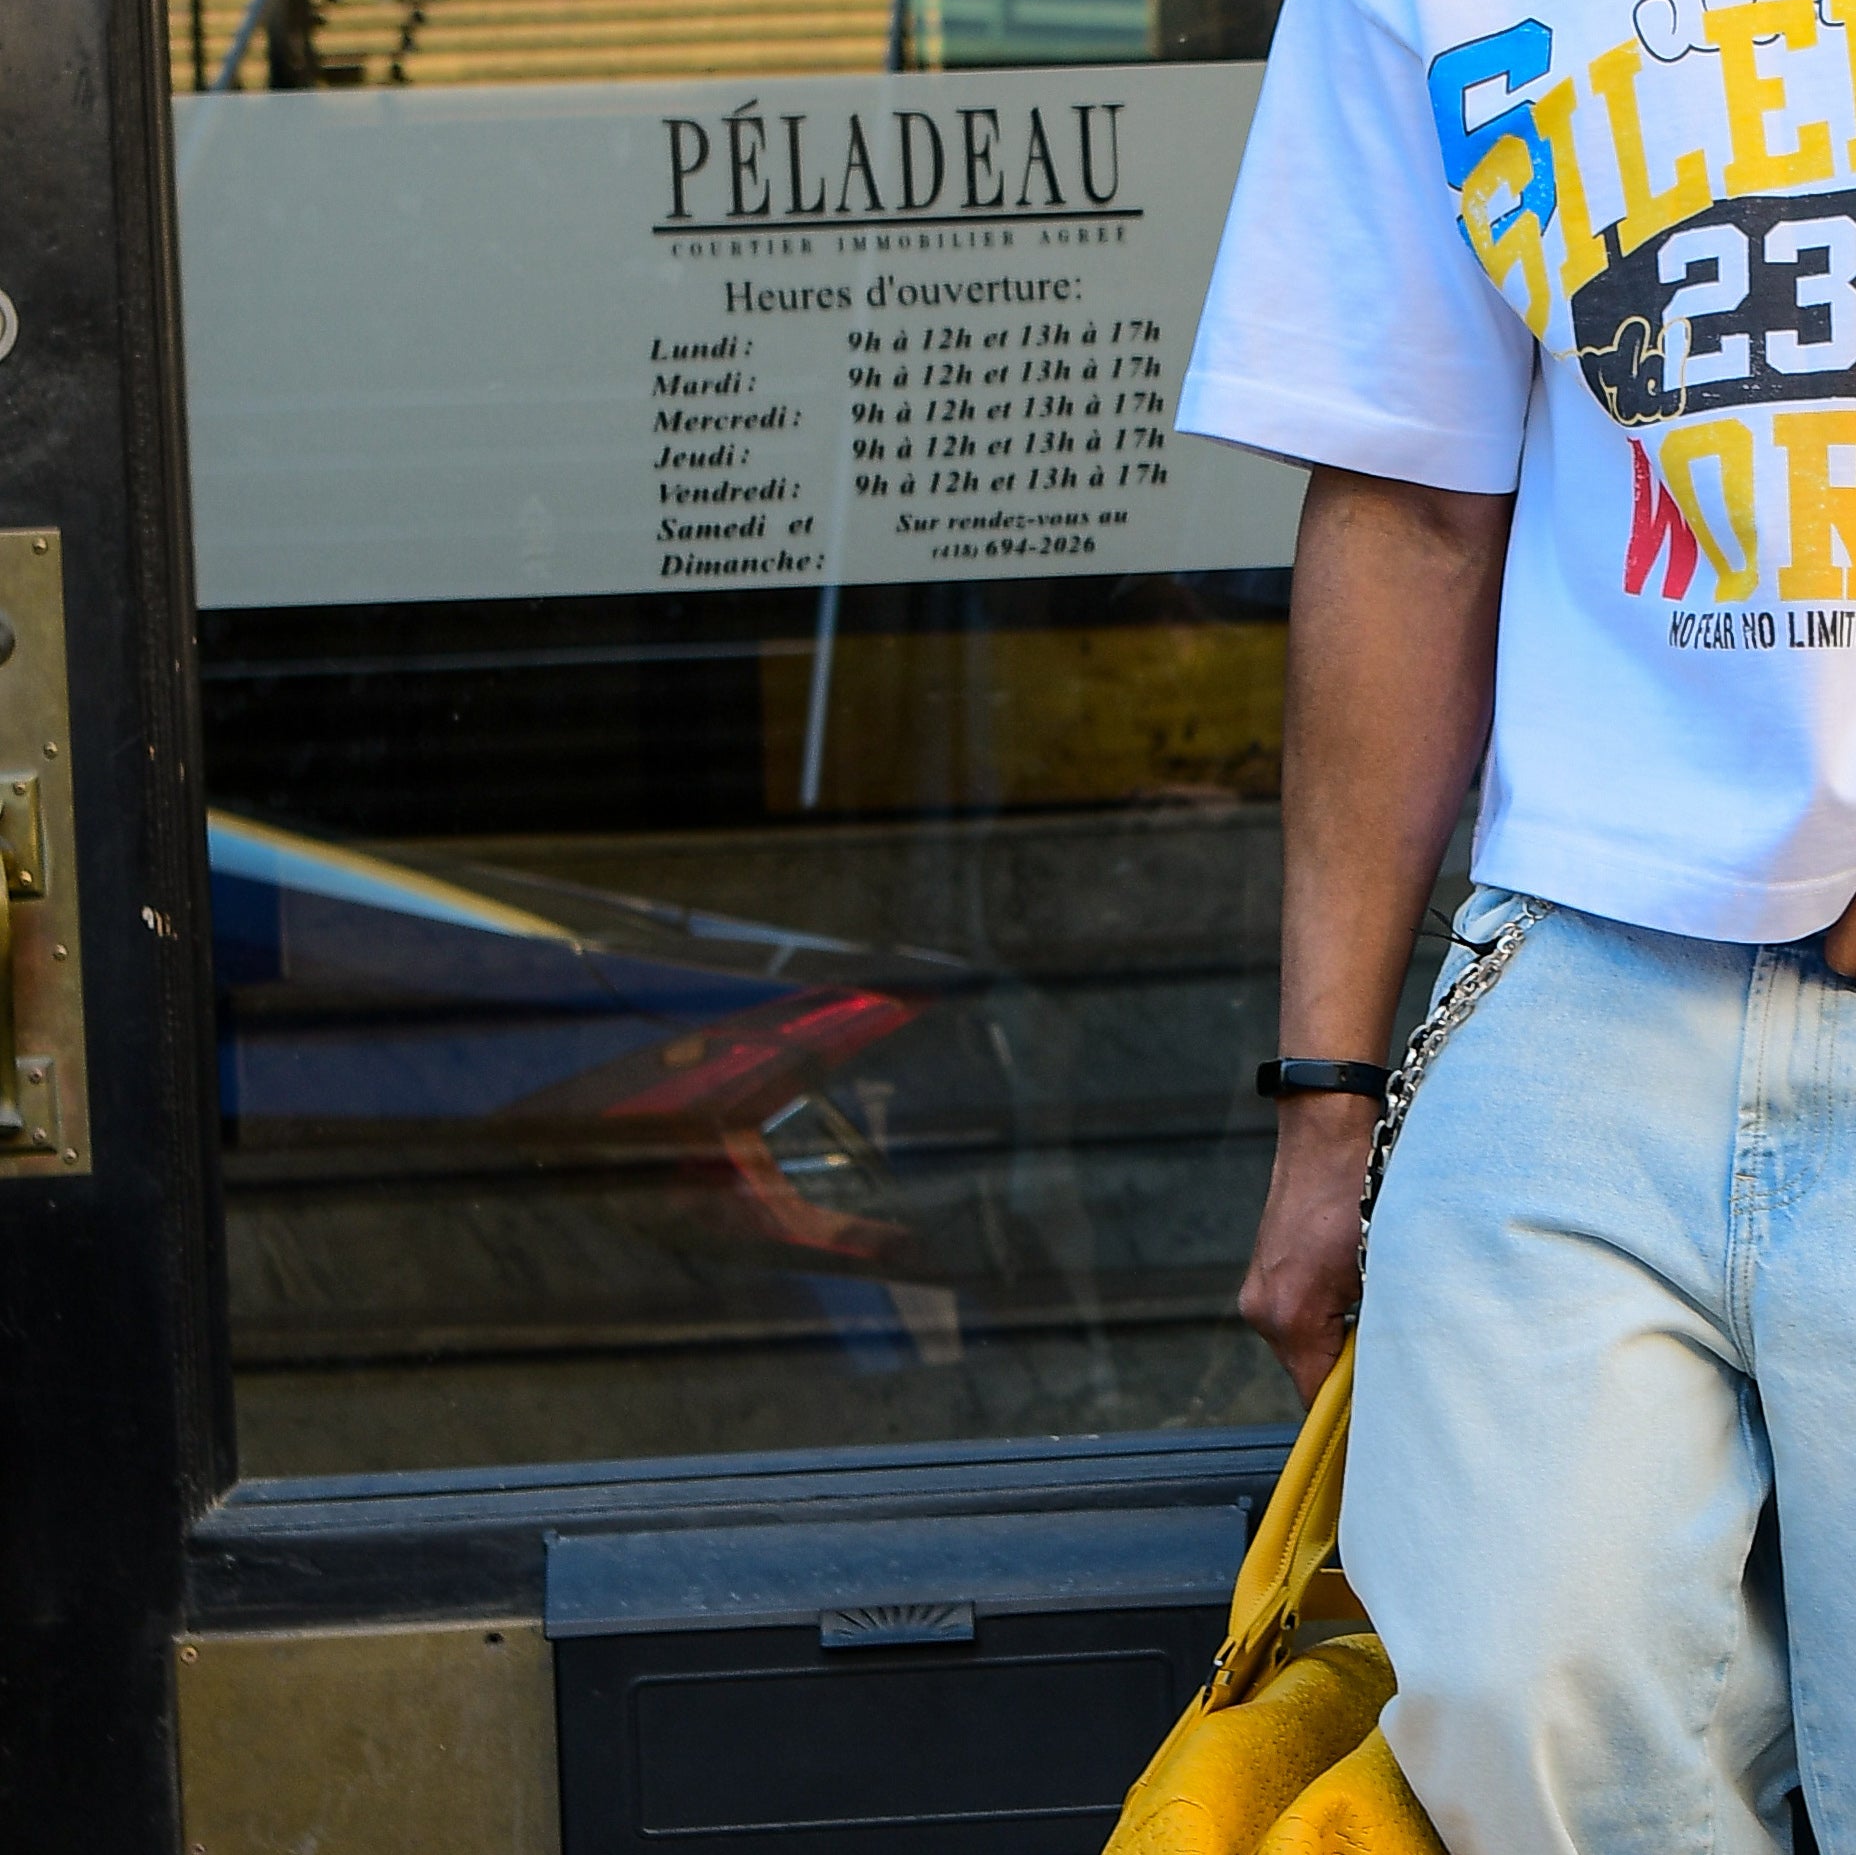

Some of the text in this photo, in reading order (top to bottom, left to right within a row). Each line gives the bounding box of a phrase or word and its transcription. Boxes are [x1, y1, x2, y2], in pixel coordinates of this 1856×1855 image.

[662, 99, 1125, 218] PÉLADEAU
[671, 238, 812, 257] COURTIER
[838, 230, 1014, 253] IMMOBILIER
[725, 275, 1082, 312] Heures d'ouverture:
[848, 331, 880, 352] 9h
[893, 330, 908, 351] à
[923, 327, 971, 350] 12h
[983, 329, 1008, 347] et
[1022, 324, 1069, 346] 13h
[1082, 321, 1097, 344] à
[1111, 320, 1160, 343] 17h
[849, 367, 881, 388] 9h
[894, 366, 908, 388] à
[924, 364, 972, 386] 12h
[984, 365, 1008, 384] et
[1022, 359, 1070, 382] 13h
[1083, 358, 1097, 380] à
[1112, 356, 1160, 378] 17h
[852, 402, 883, 424] 9h
[896, 401, 911, 424] à
[926, 399, 975, 421] 12h
[987, 401, 1011, 420] et
[1025, 395, 1073, 418] 13h
[1085, 394, 1100, 416] à
[1115, 392, 1163, 414] 17h
[853, 438, 884, 460] 9h
[897, 436, 912, 459] à
[927, 435, 975, 458] 12h
[988, 437, 1012, 455] et
[1025, 431, 1074, 454] 13h
[1086, 429, 1101, 452] à
[1116, 428, 1164, 450] 17h
[855, 474, 888, 495] 9h
[901, 472, 915, 495] à
[930, 471, 979, 494] 12h
[991, 473, 1015, 492] et
[1029, 467, 1077, 490] 13h
[1089, 465, 1104, 487] à
[1119, 463, 1167, 486] 17h
[657, 514, 813, 541] Samedi et
[896, 508, 1128, 532] Sur rendez-vous au
[1669, 610, 1696, 648] NO
[1694, 612, 1735, 649] FEAR
[1742, 612, 1775, 649] NO
[1788, 611, 1855, 648] LIMIT
